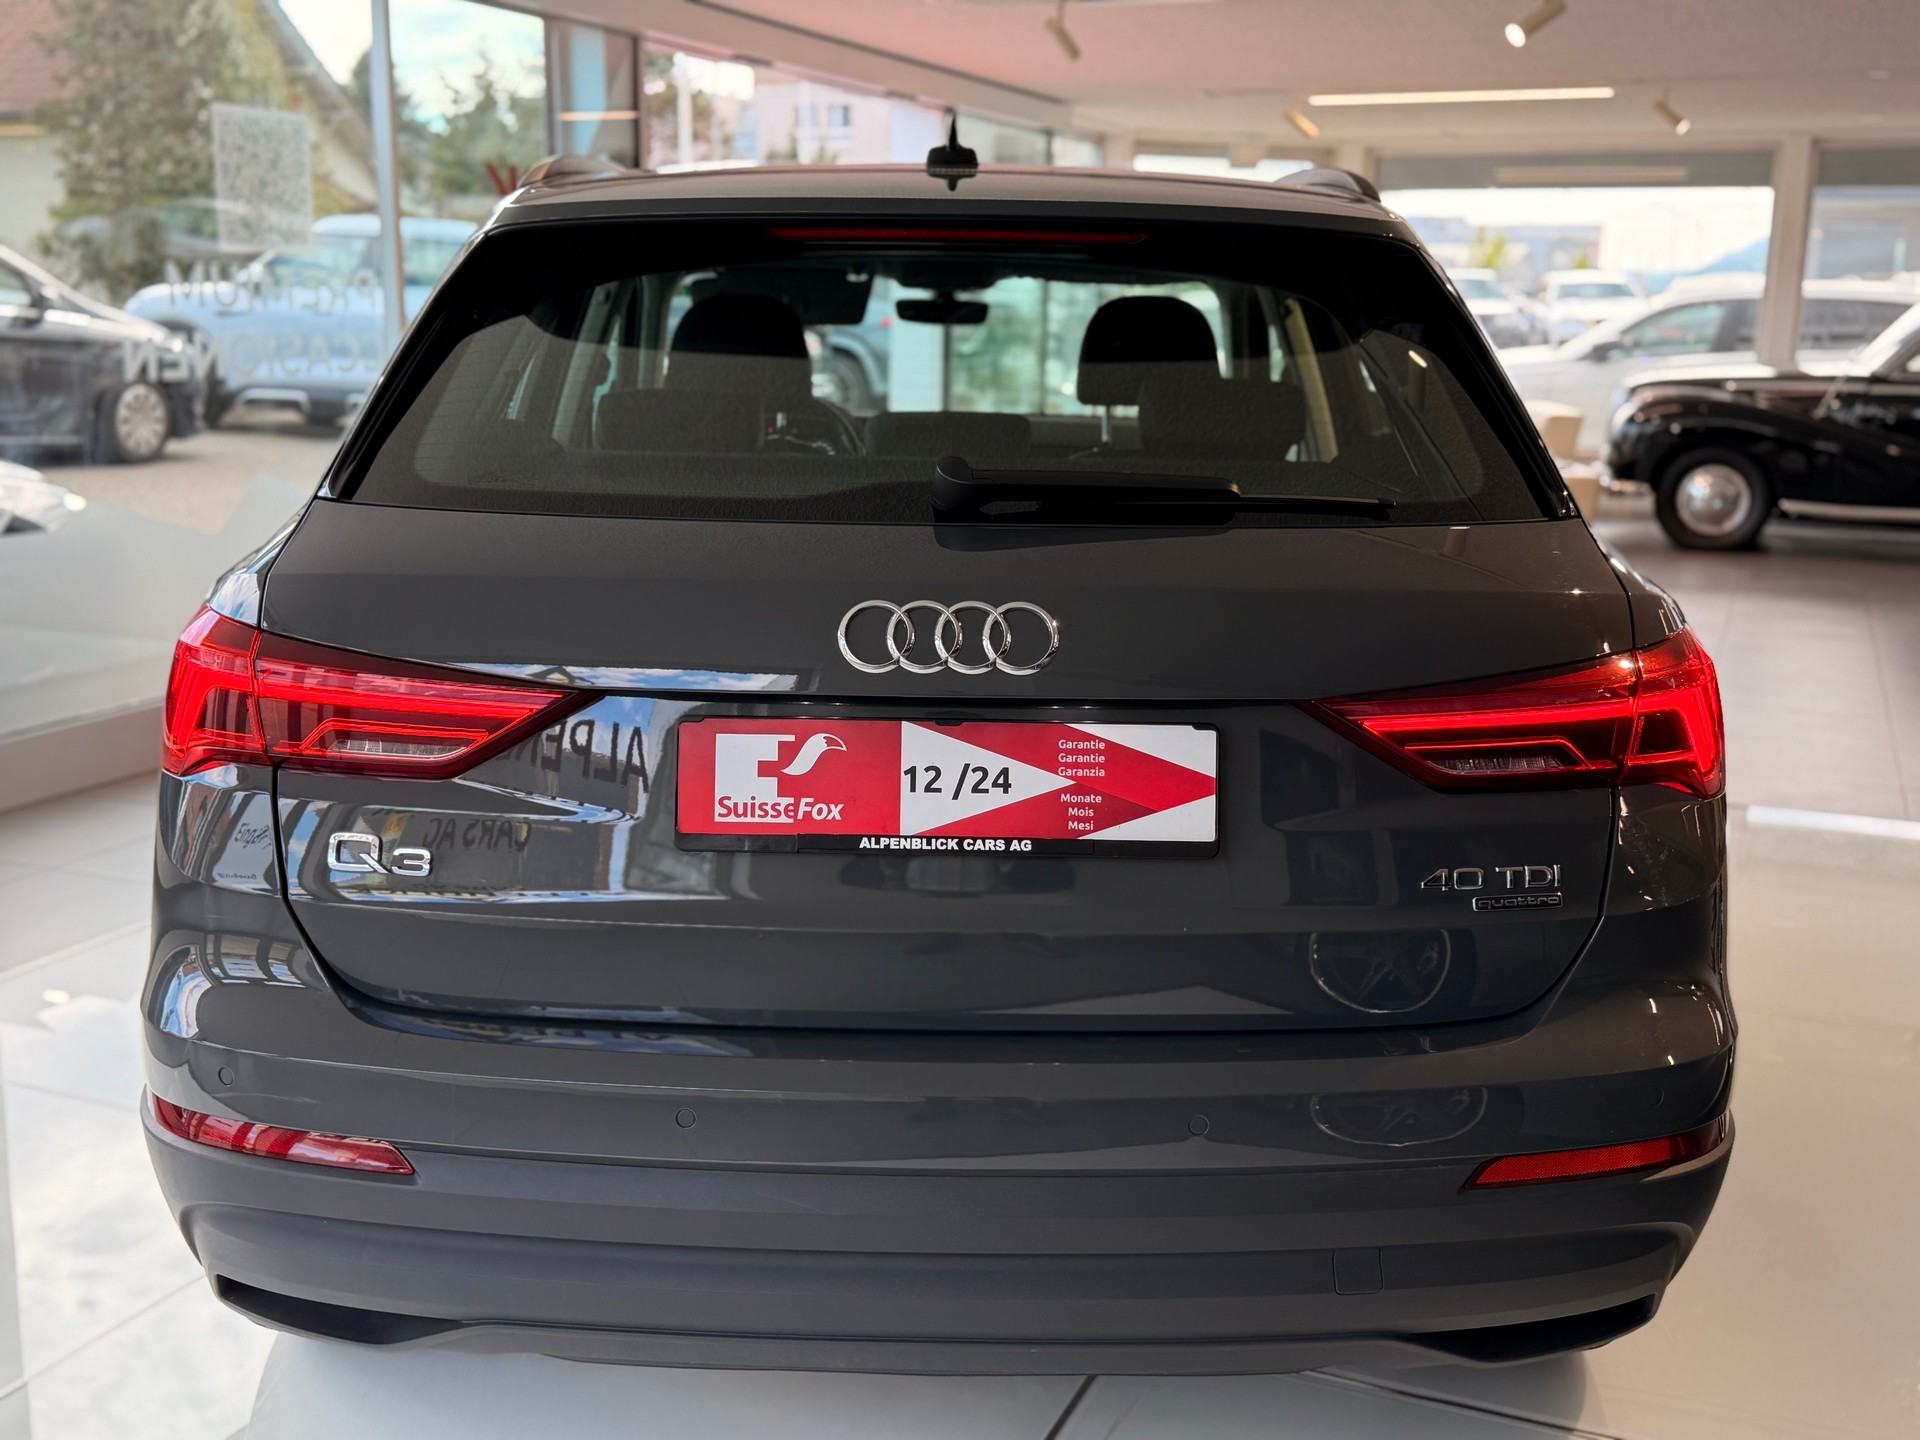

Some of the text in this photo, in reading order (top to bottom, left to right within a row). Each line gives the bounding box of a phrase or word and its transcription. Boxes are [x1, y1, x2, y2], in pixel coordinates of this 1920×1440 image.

[1058, 740, 1106, 750] Garantie
[1058, 753, 1106, 763] Garantie
[1058, 767, 1106, 777] Garanzia
[903, 765, 943, 794] 12
[1060, 793, 1102, 804] Monate
[1068, 807, 1094, 817] Mois
[1068, 821, 1094, 831] Mesi
[859, 837, 1032, 852] ALPENBLICK CARS AG
[327, 833, 432, 877] Q3
[1421, 865, 1561, 891] 40 TDI
[1478, 896, 1560, 909] quattro
